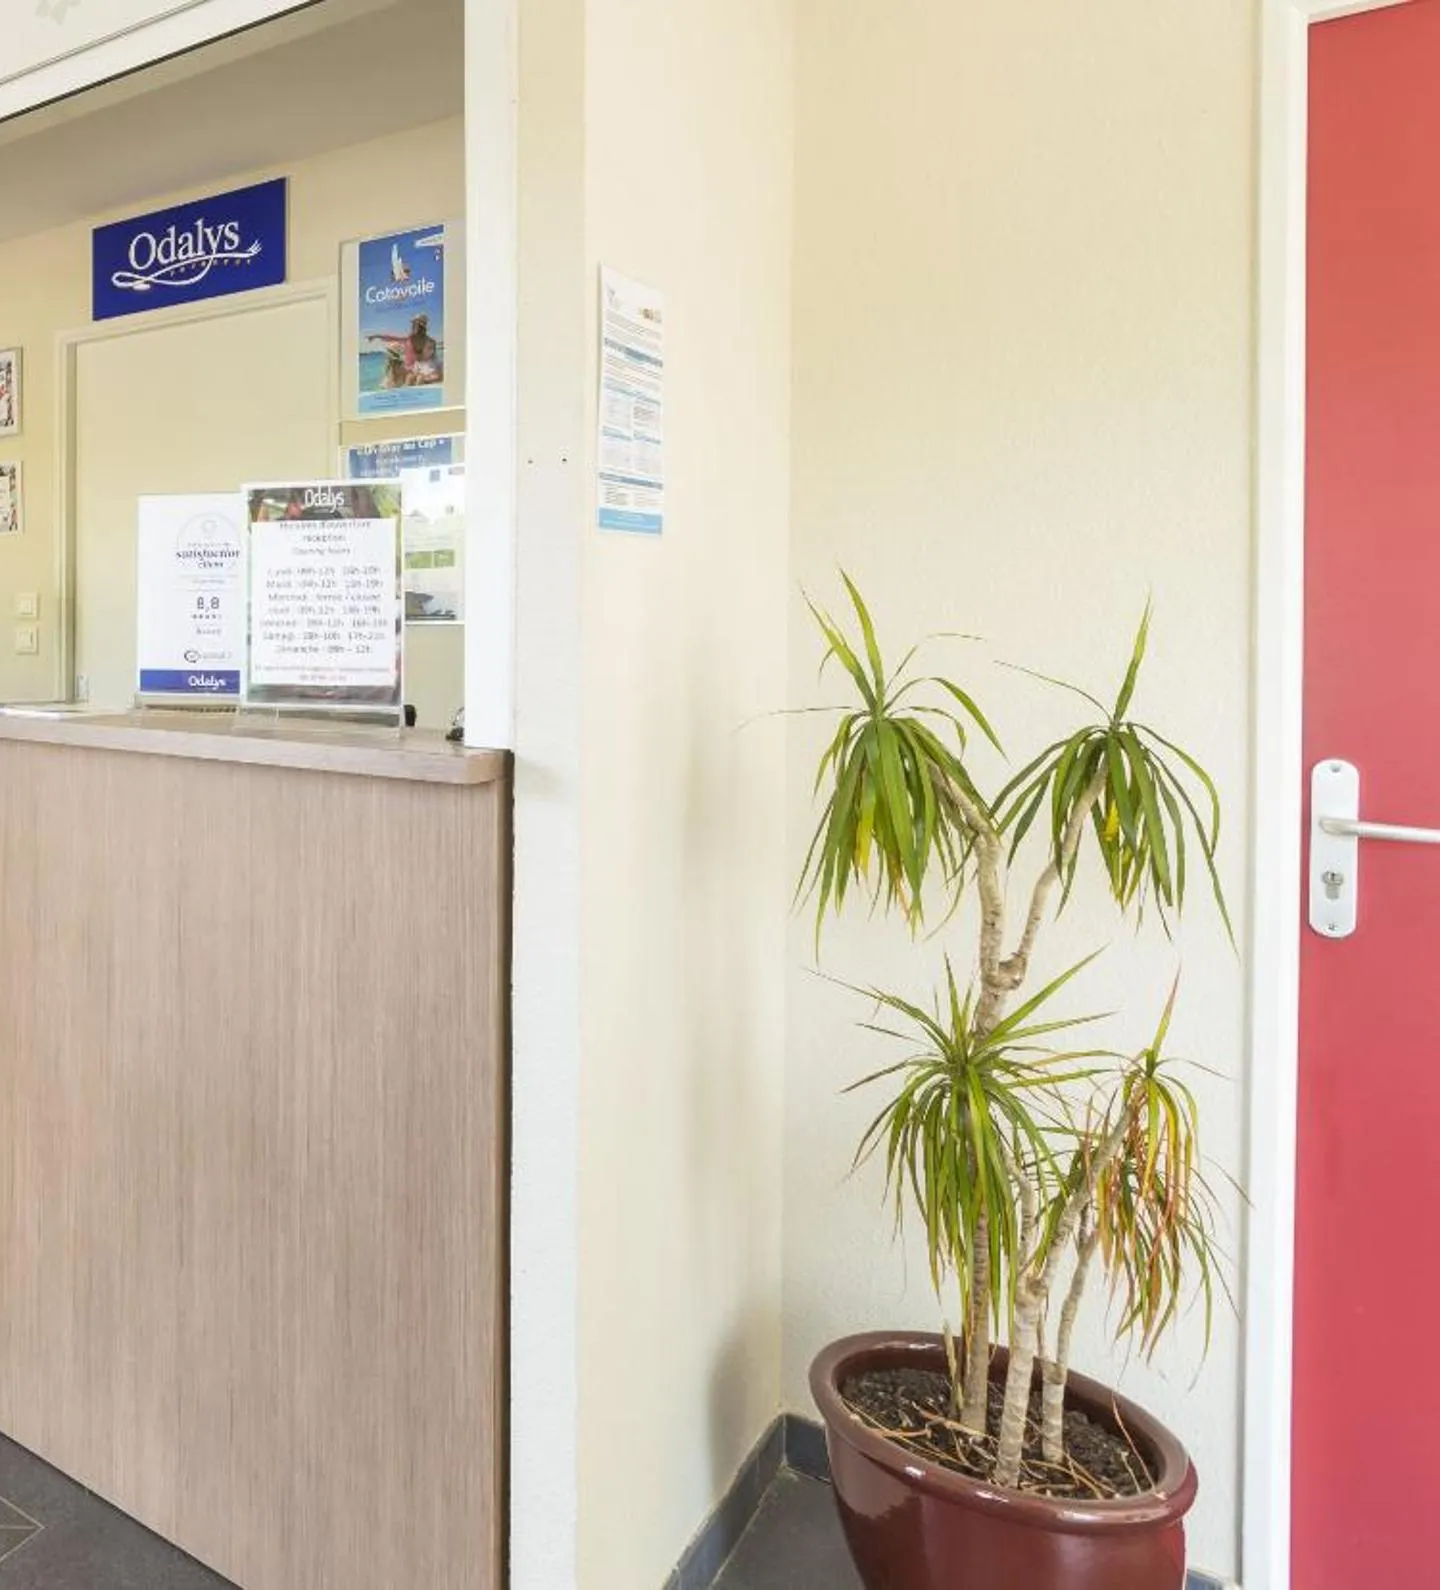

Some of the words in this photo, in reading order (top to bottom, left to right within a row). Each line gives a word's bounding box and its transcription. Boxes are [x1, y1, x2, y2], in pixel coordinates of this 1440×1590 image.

[128, 217, 239, 271] Odalys
[304, 484, 344, 513] Odalys
[187, 672, 227, 691] Odalys
